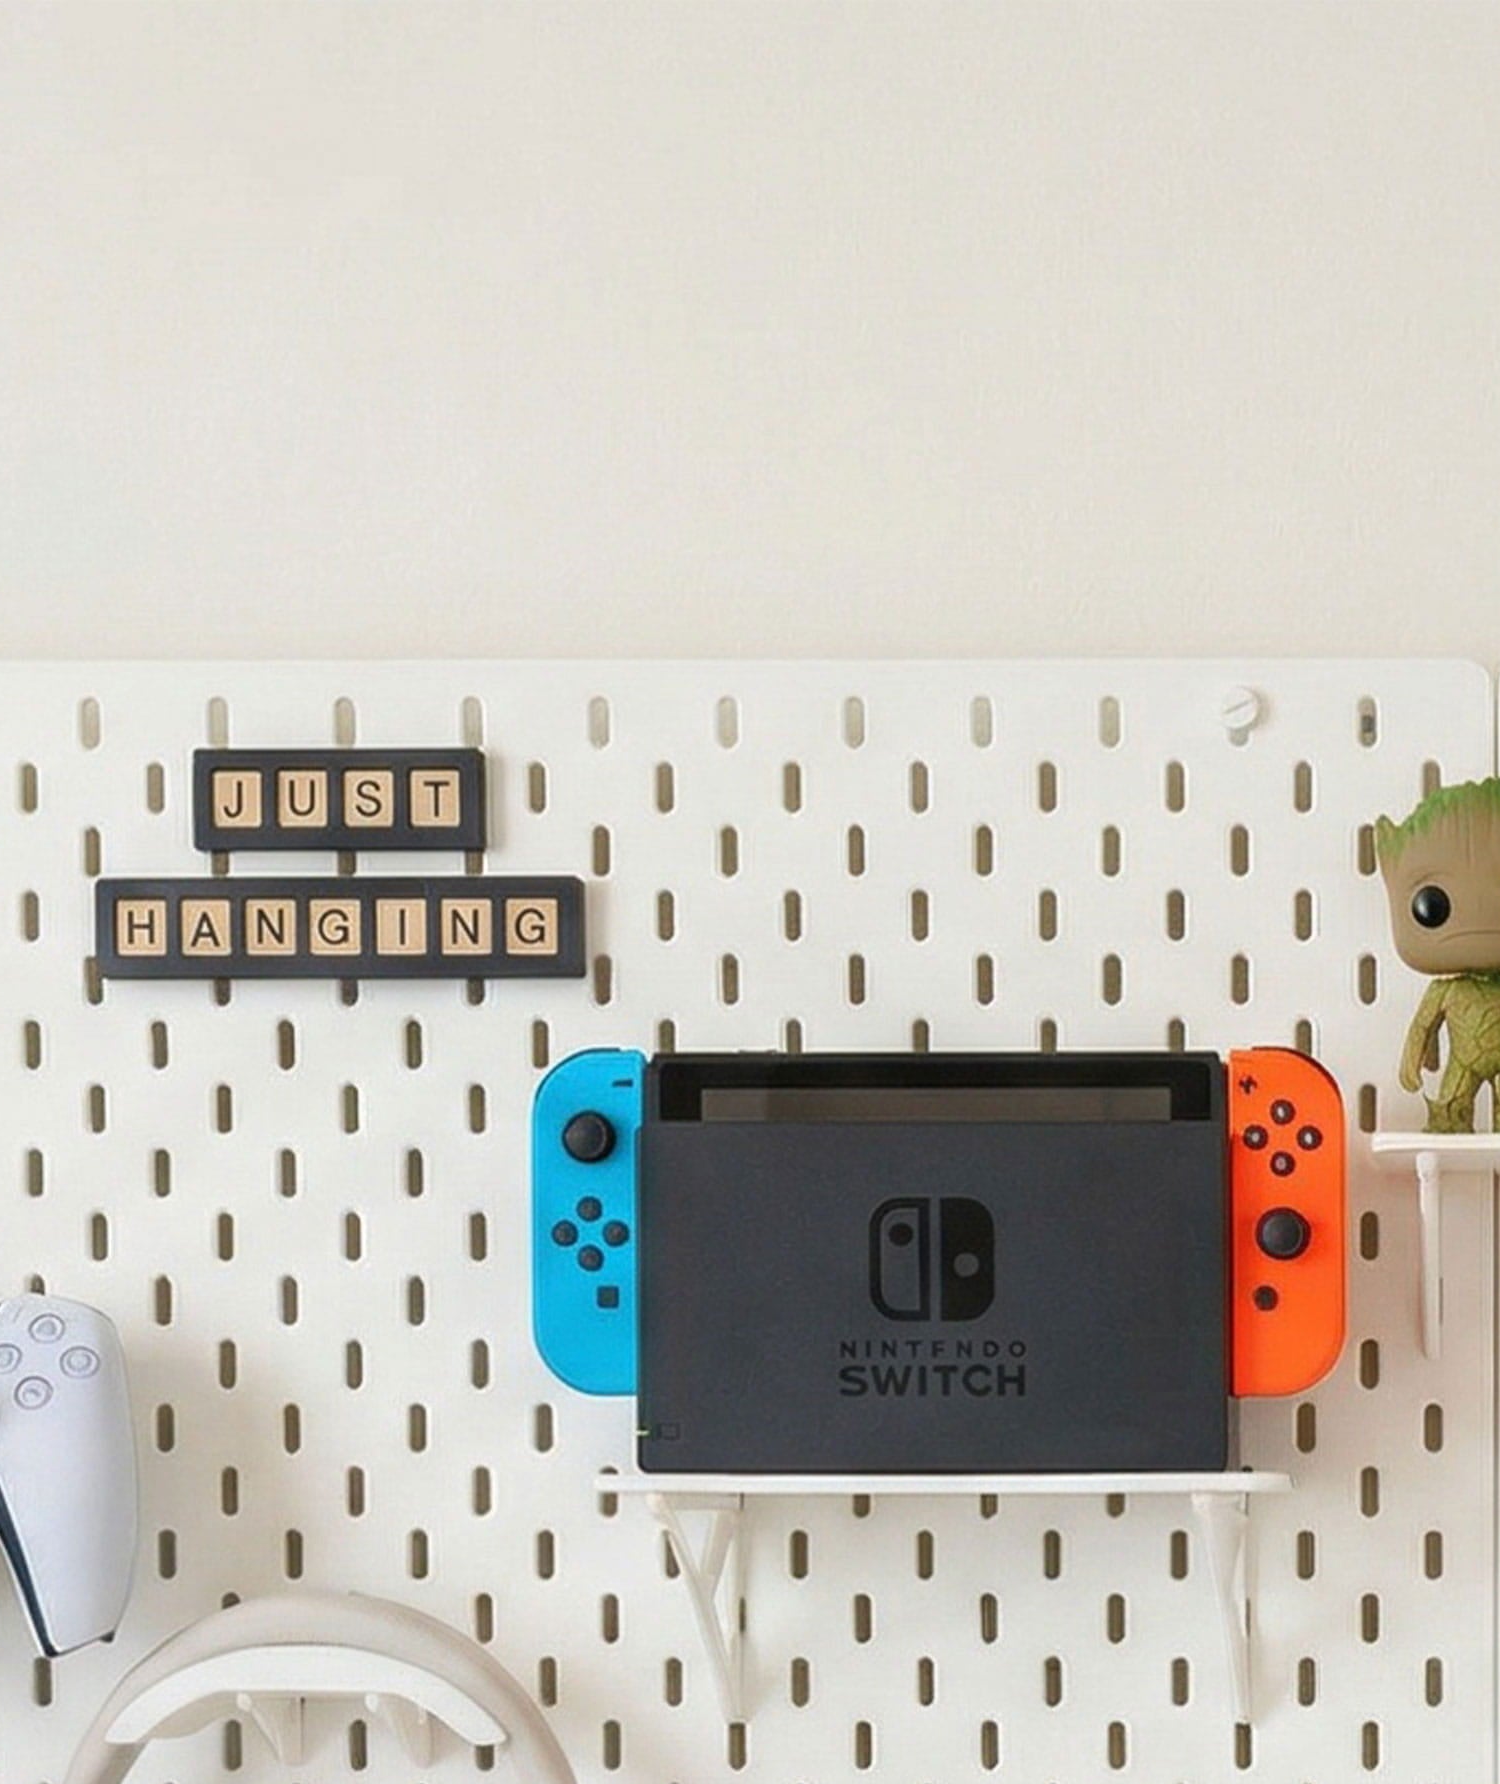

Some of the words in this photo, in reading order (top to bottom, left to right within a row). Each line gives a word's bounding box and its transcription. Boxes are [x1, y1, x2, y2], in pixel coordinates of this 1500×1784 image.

[223, 780, 451, 818] JUST
[126, 908, 546, 948] HANGING
[838, 1364, 1026, 1397] SWITCH
